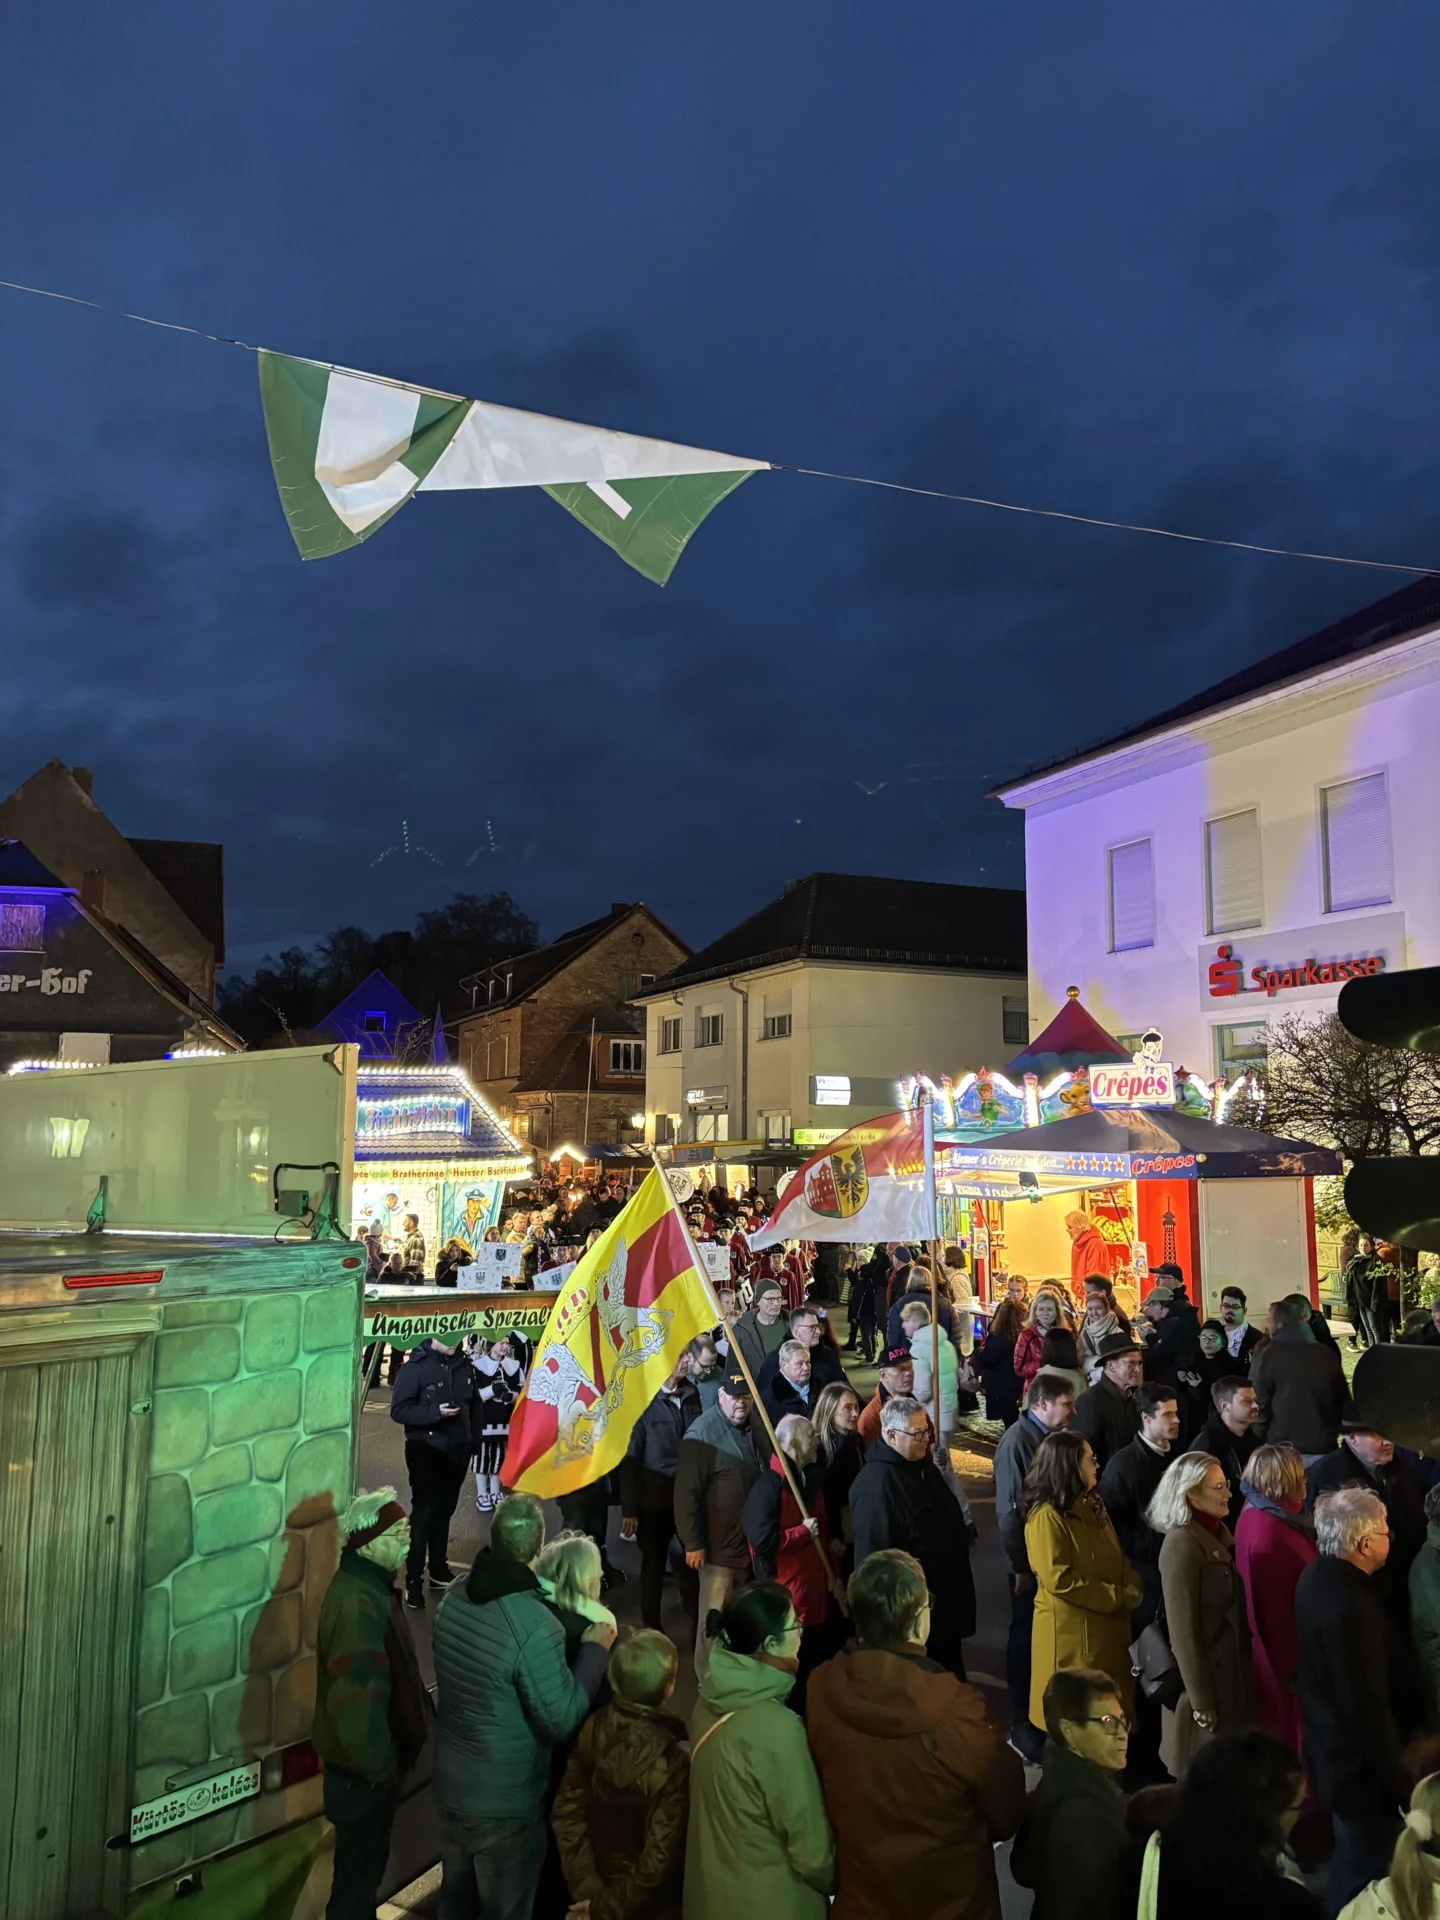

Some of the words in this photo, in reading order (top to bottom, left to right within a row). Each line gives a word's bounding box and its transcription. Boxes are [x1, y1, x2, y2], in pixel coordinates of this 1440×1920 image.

[1251, 956, 1380, 998] Sparkasse
[1092, 1071, 1168, 1101] Crêpes
[392, 1169, 444, 1180] Bratheringe
[453, 1167, 485, 1177] Heisser
[1131, 1154, 1195, 1175] Crêpes
[371, 1308, 476, 1341] Ungarische
[132, 1800, 186, 1836] Kürtös
